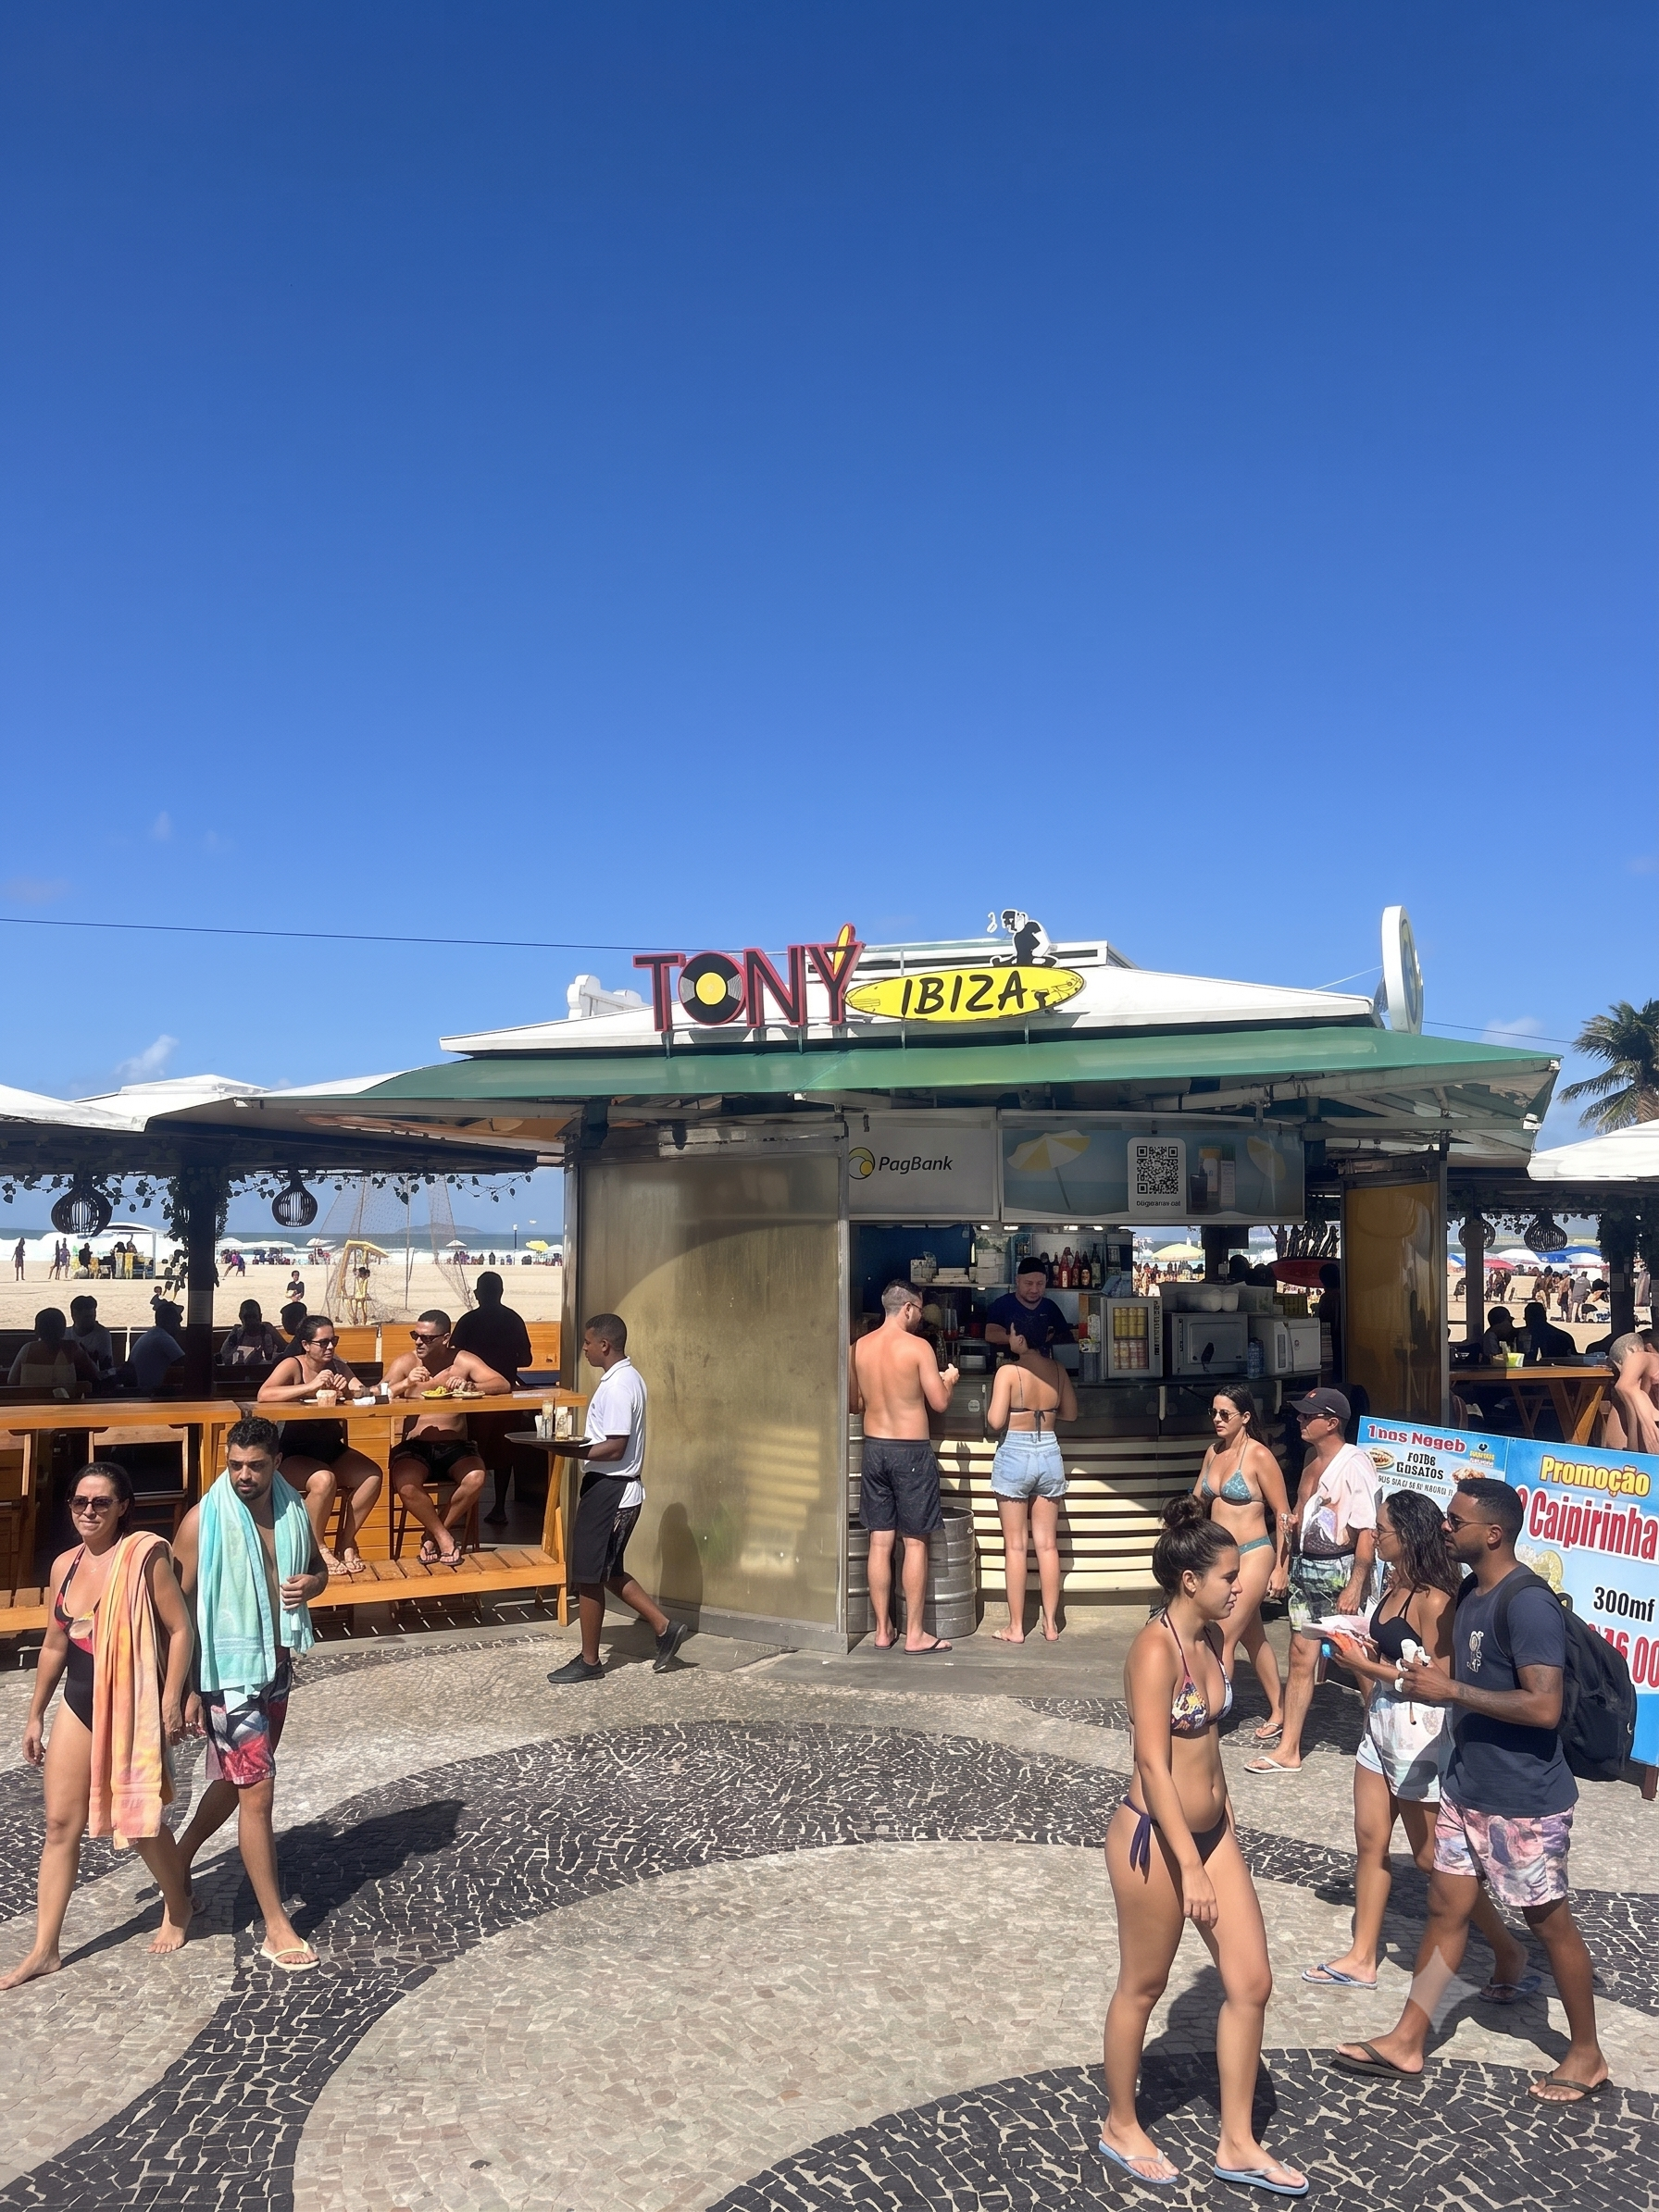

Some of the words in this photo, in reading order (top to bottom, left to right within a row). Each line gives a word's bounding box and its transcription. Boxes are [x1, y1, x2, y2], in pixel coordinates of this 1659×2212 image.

[633, 929, 865, 1032] TONY
[901, 970, 1028, 1016] IBIZA
[879, 1155, 954, 1174] PagBank
[1540, 1455, 1651, 1497] Promoção
[1529, 1490, 1658, 1560] Caipirinha
